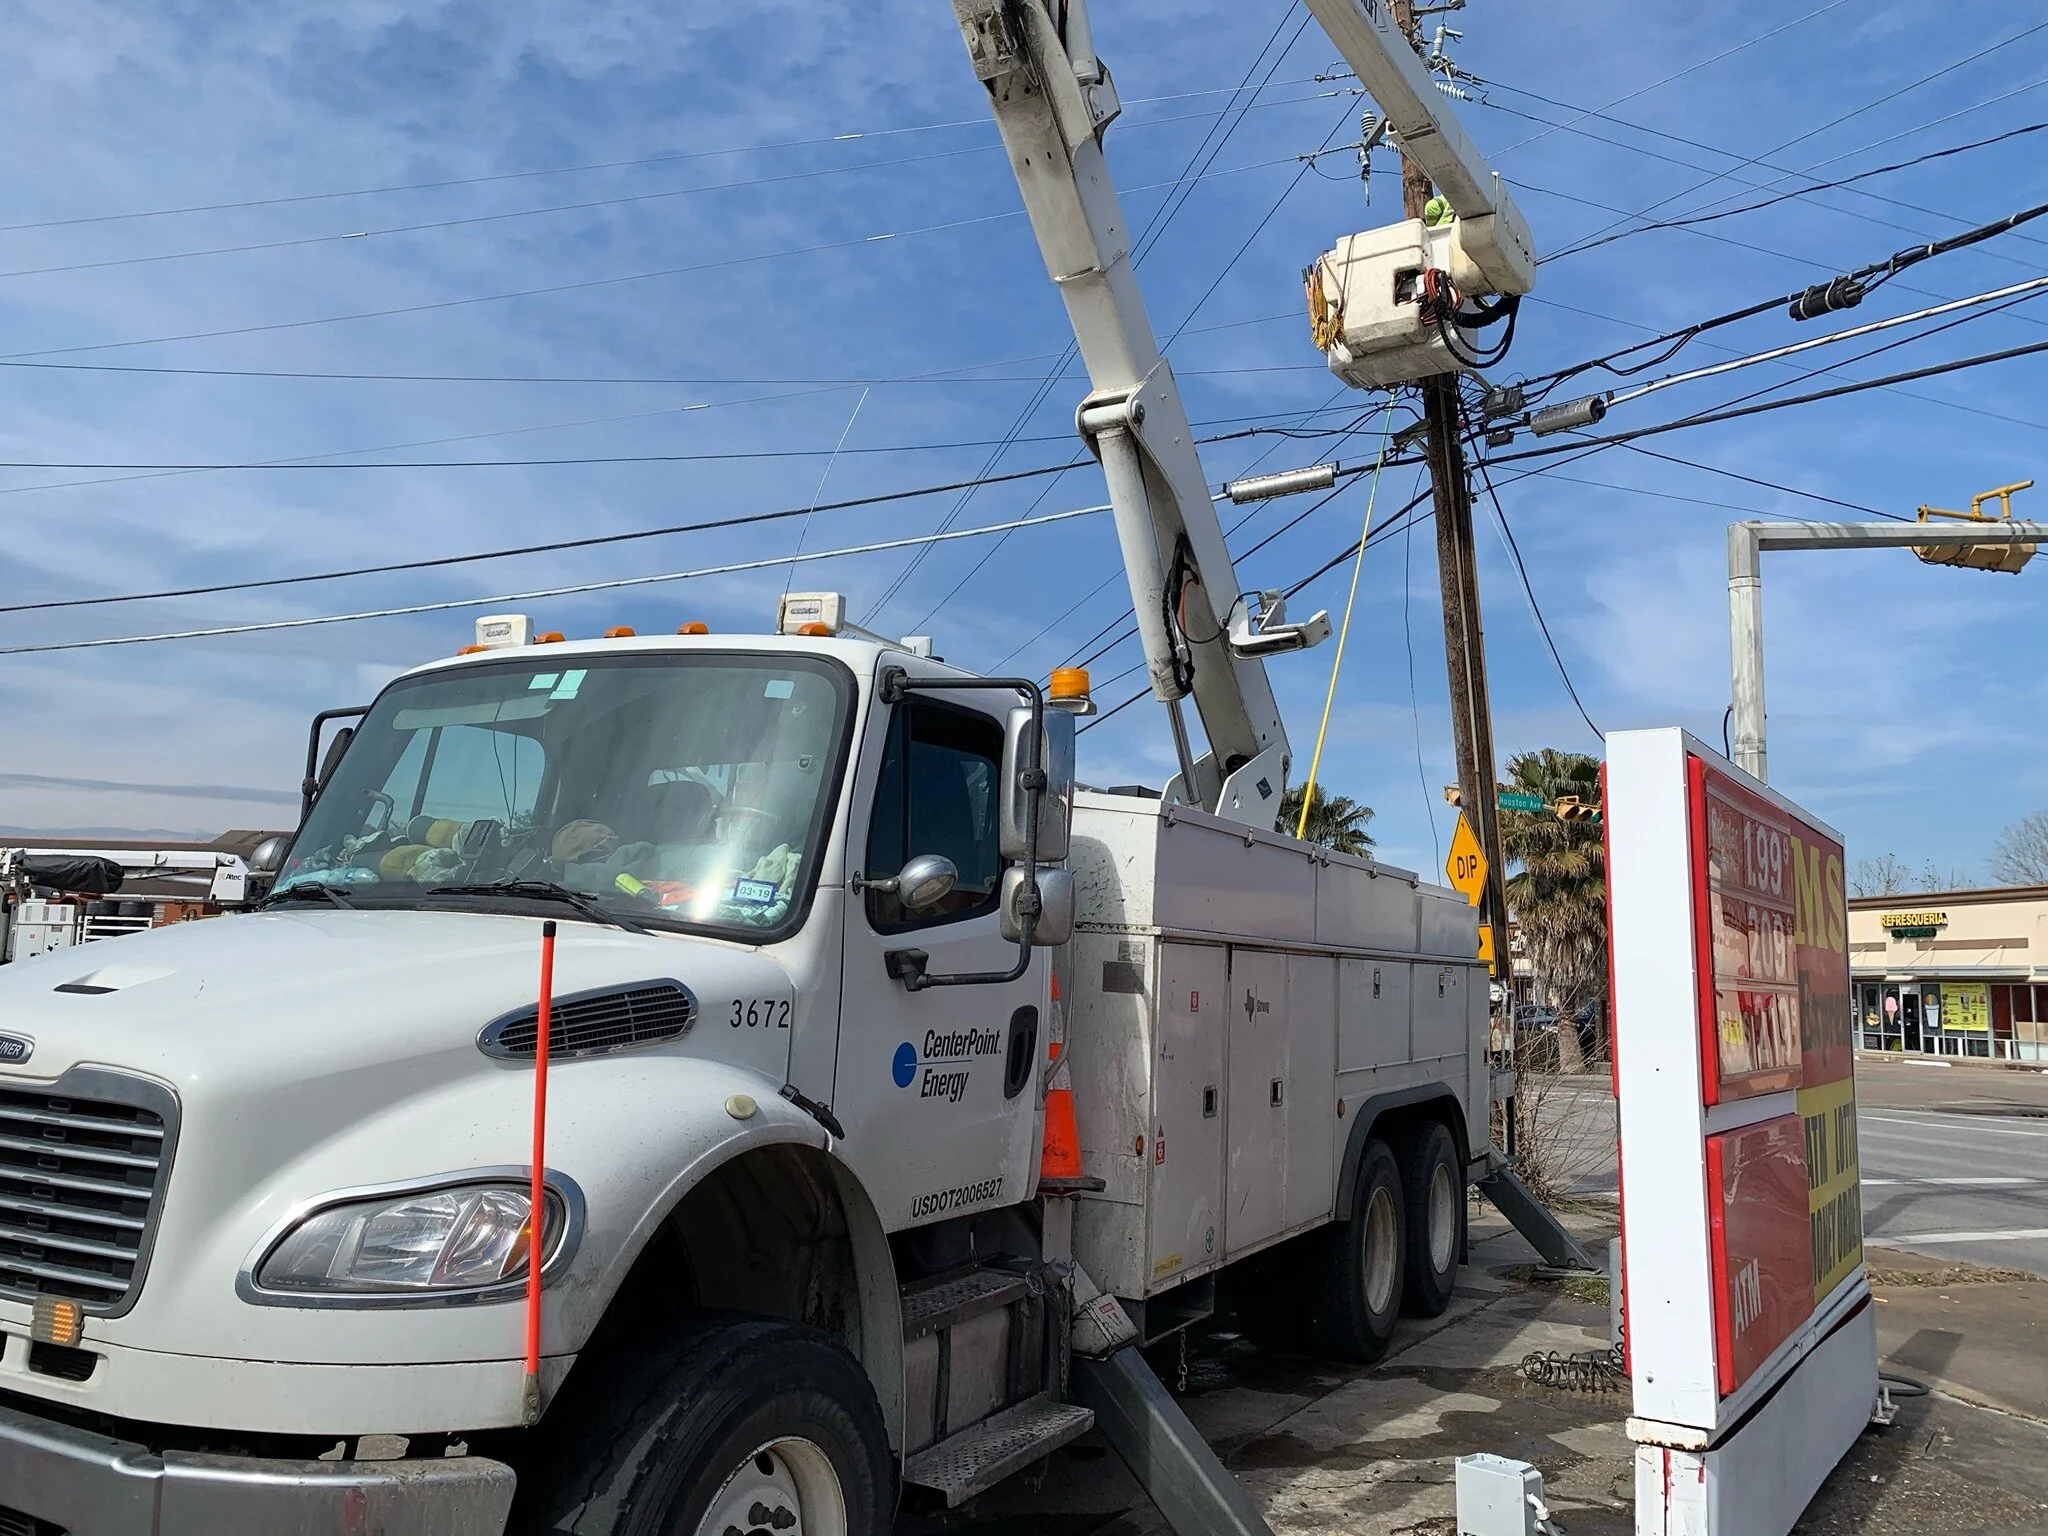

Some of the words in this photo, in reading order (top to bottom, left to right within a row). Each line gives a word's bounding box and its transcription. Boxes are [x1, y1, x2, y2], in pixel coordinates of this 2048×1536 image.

[1498, 796, 1527, 808] Houston
[1529, 800, 1542, 810] Ave
[1456, 854, 1478, 880] DIP
[740, 886, 753, 896] 03
[758, 889, 771, 899] 19
[1880, 912, 1948, 927] REFRESQUERIA
[729, 998, 791, 1029] 3672
[920, 1068, 970, 1103] Energy
[911, 1177, 1003, 1218] USDOT2006527
[1735, 1257, 1763, 1340] ATM
